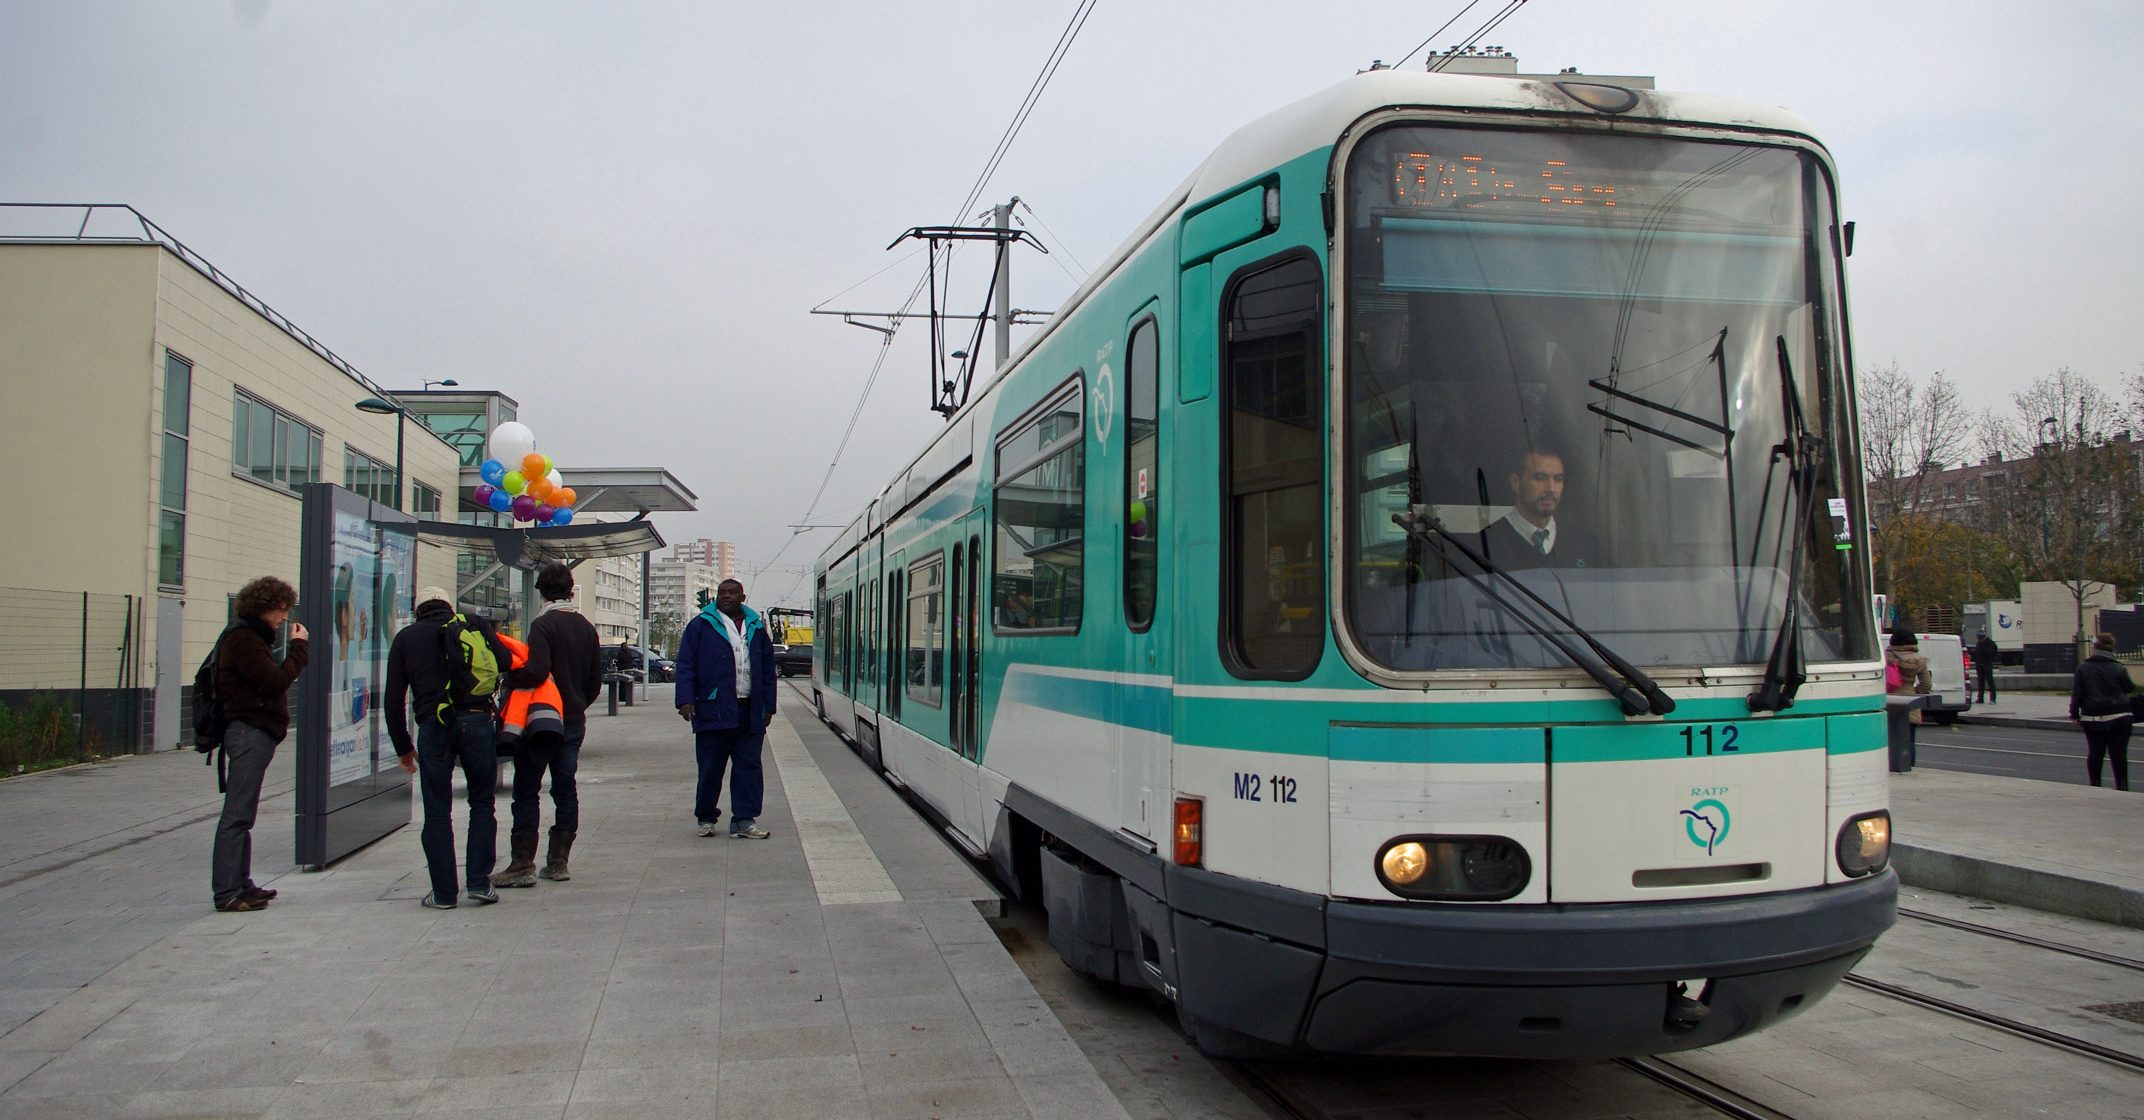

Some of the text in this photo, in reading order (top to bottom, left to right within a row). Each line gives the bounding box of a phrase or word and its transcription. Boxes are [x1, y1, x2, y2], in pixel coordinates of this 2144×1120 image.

[1680, 725, 1739, 756] 112
[1234, 772, 1297, 803] M2 112
[1691, 787, 1729, 797] RATP
